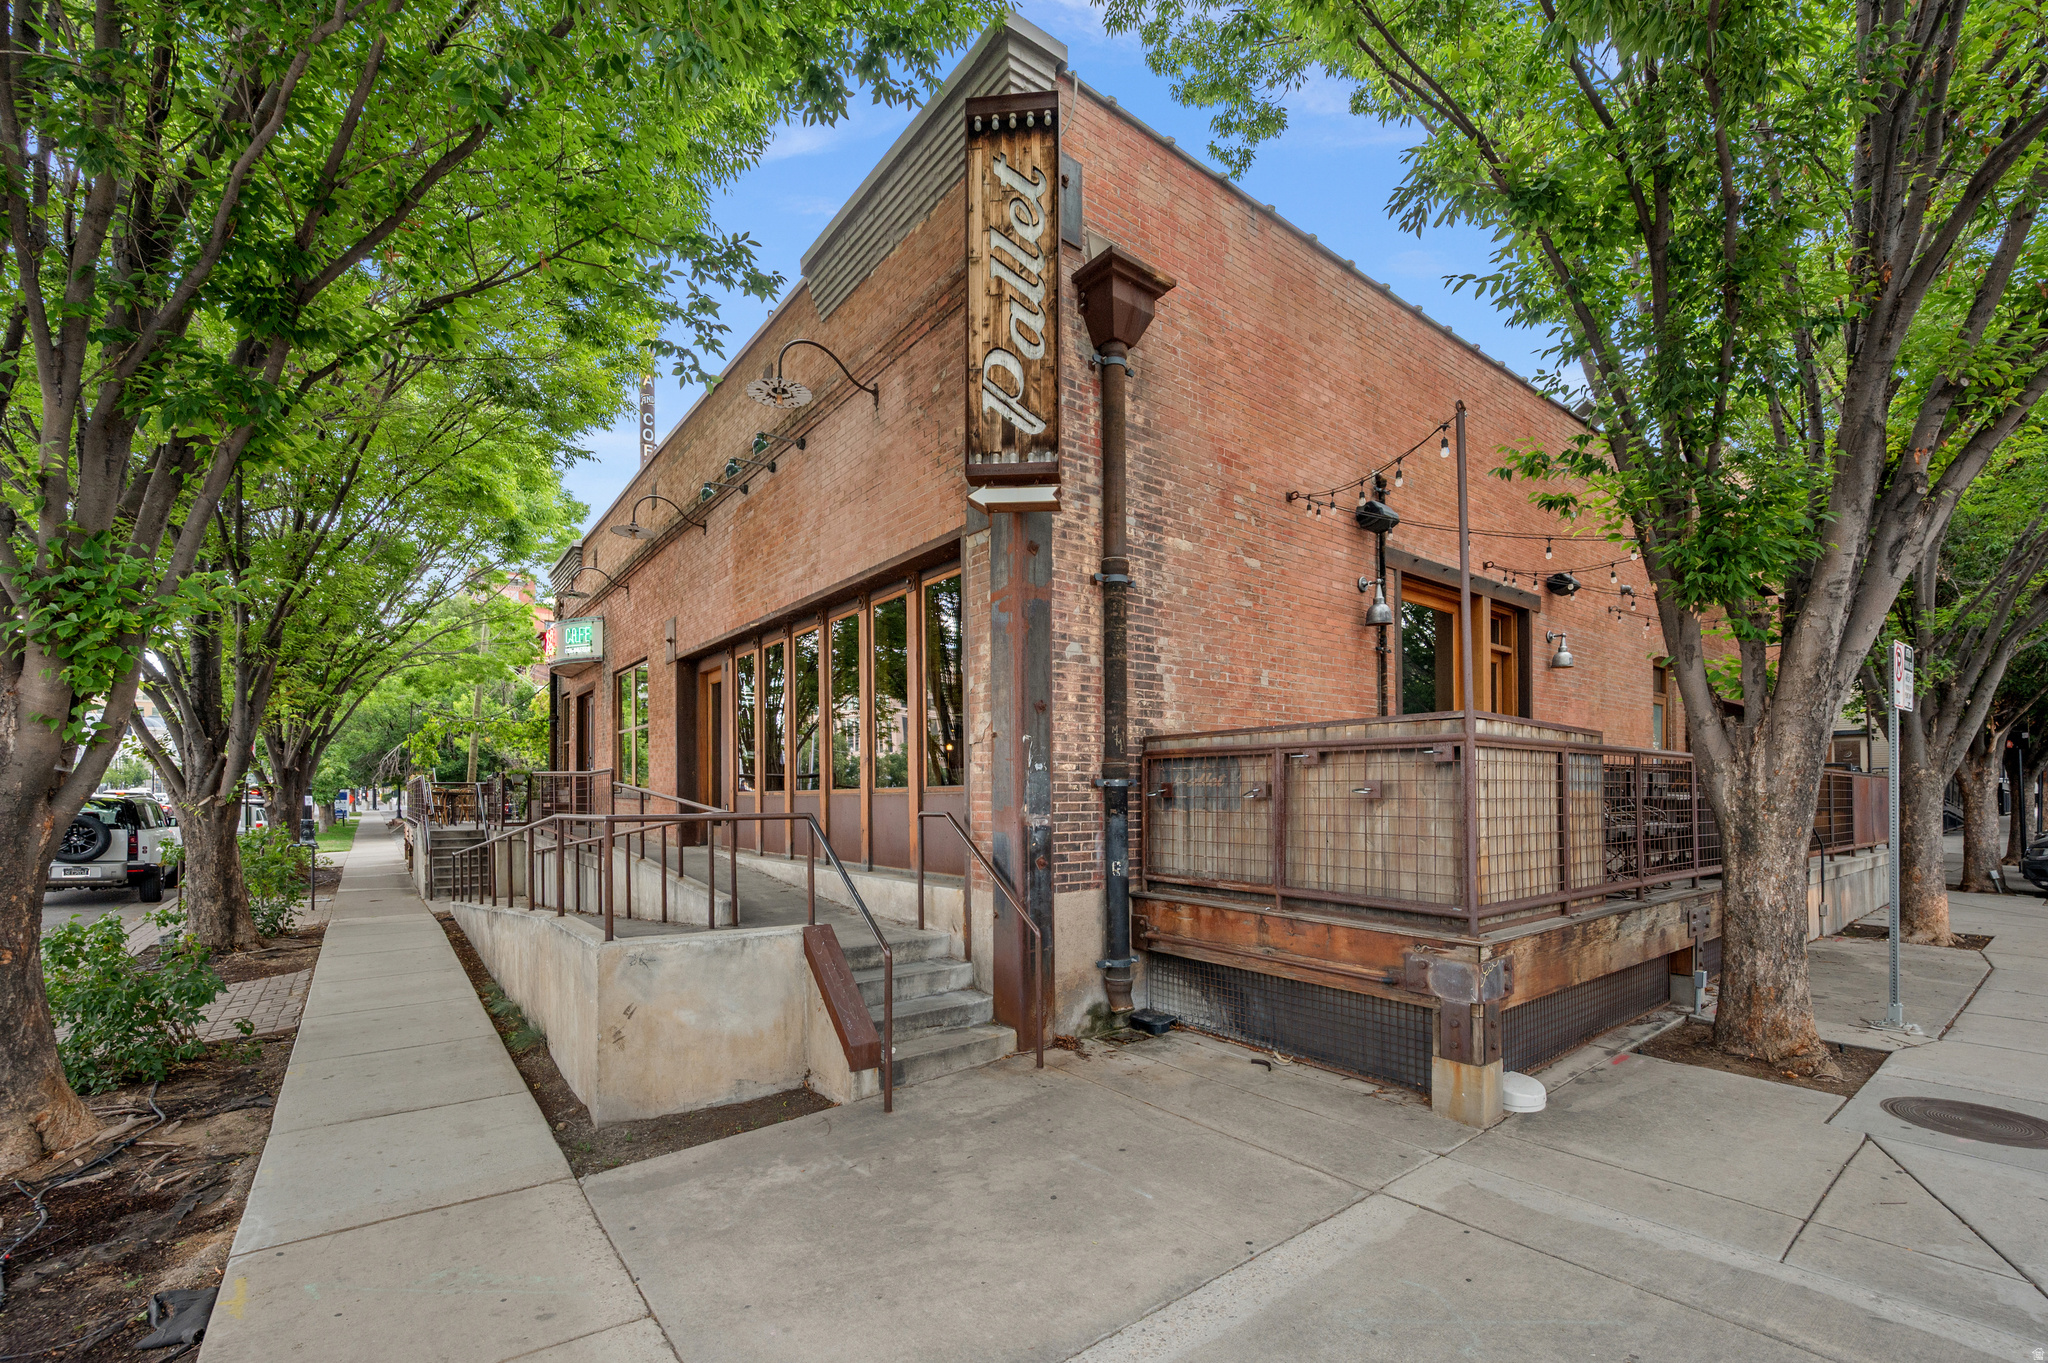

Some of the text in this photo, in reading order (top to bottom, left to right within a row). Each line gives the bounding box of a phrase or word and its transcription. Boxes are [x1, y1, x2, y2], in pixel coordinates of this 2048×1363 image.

[981, 151, 1048, 436] Pallet
[642, 412, 654, 463] COF
[565, 626, 592, 644] CAFE
